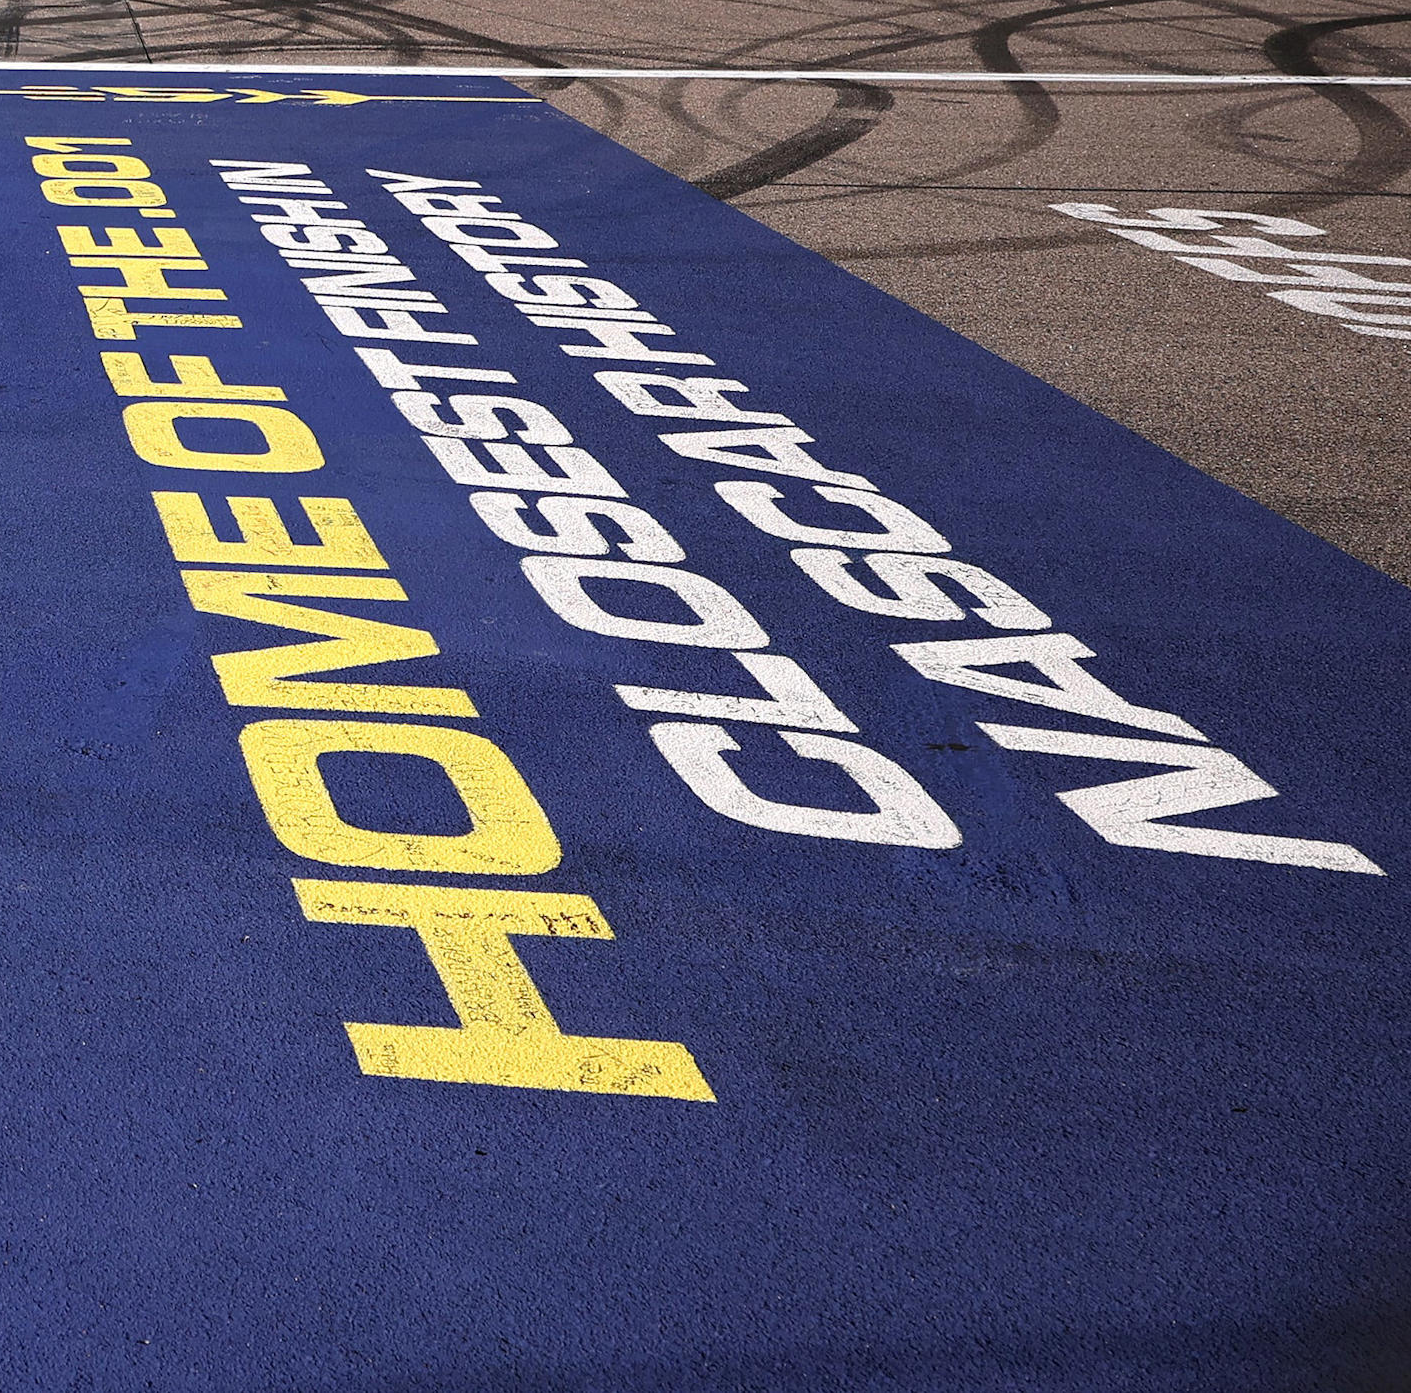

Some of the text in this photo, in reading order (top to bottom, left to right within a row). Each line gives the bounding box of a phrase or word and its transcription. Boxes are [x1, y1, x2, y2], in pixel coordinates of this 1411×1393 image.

[56, 223, 244, 341] THE
[101, 350, 325, 474] OF
[365, 167, 1386, 877] NASCAR HISTORY
[152, 489, 718, 1103] HOME
[354, 346, 964, 851] CLOSEST
